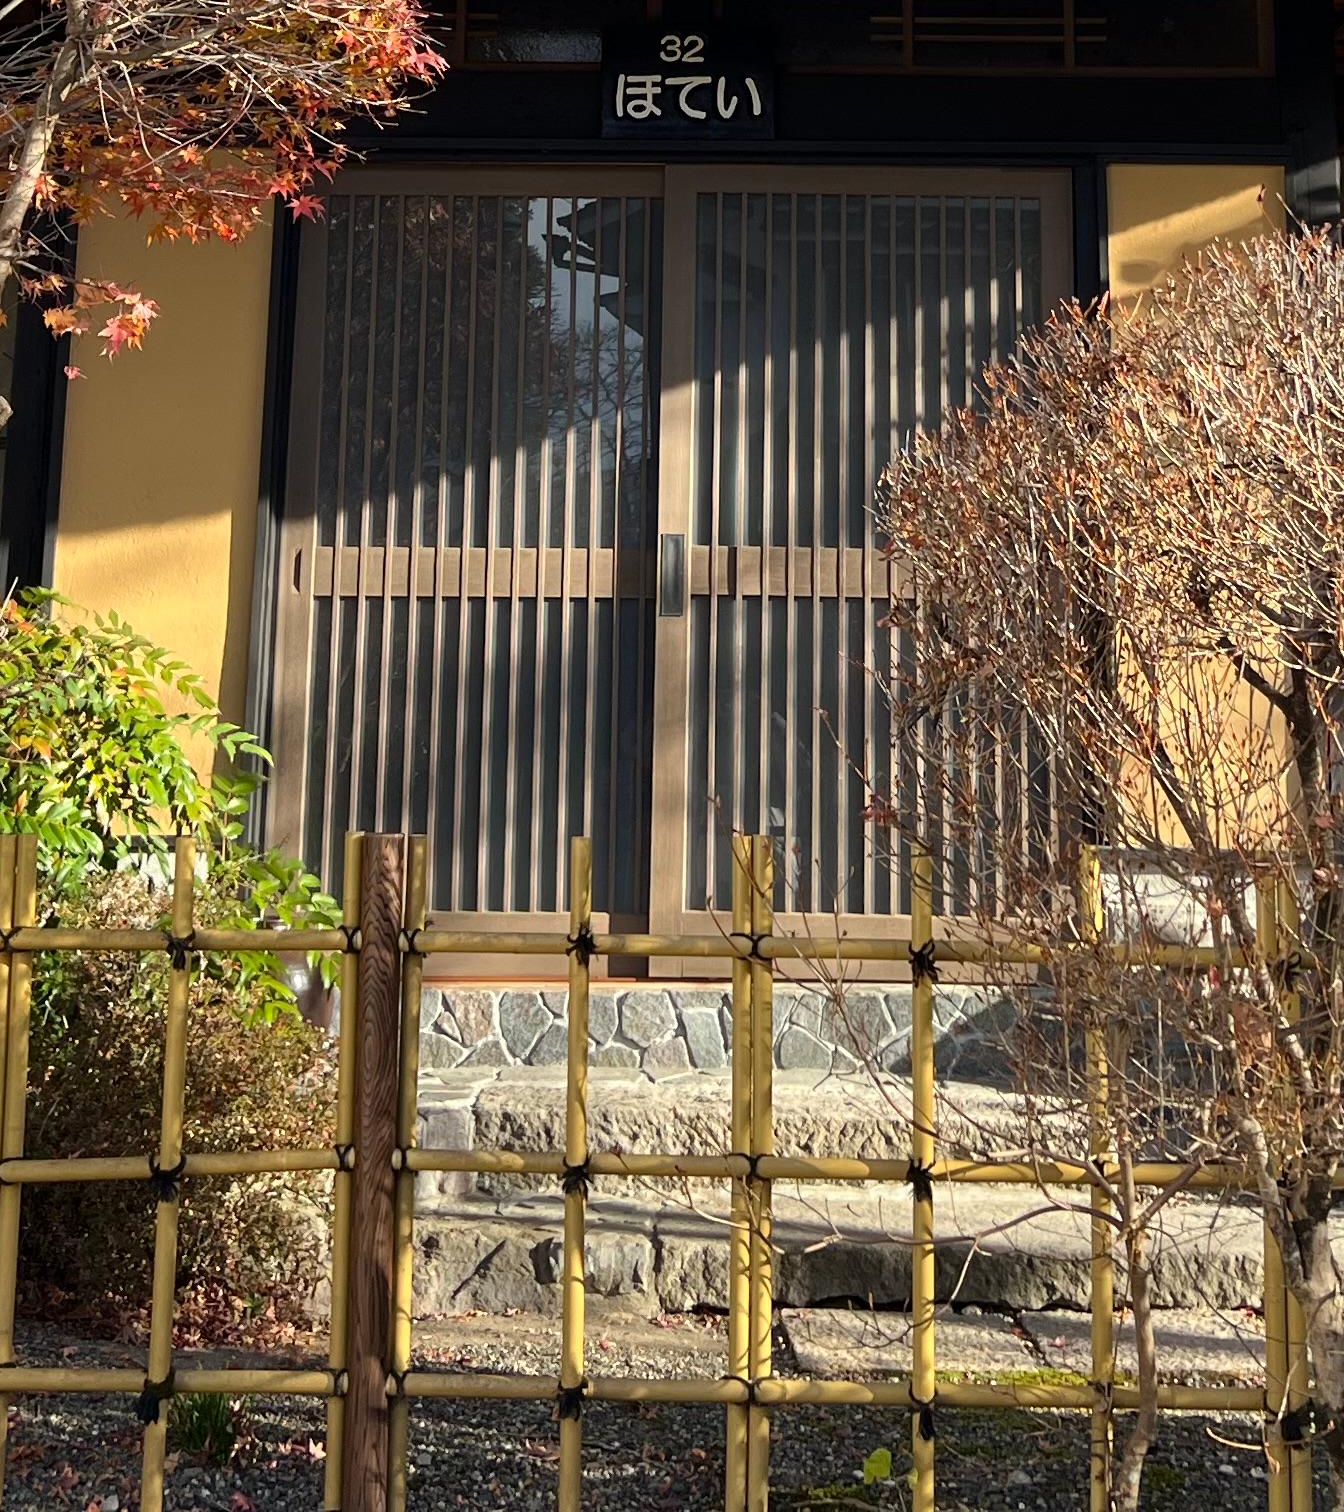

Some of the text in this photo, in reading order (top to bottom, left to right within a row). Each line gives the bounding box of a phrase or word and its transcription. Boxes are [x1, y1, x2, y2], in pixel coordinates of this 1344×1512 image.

[659, 35, 705, 63] 32
[615, 73, 762, 120] ほてい
